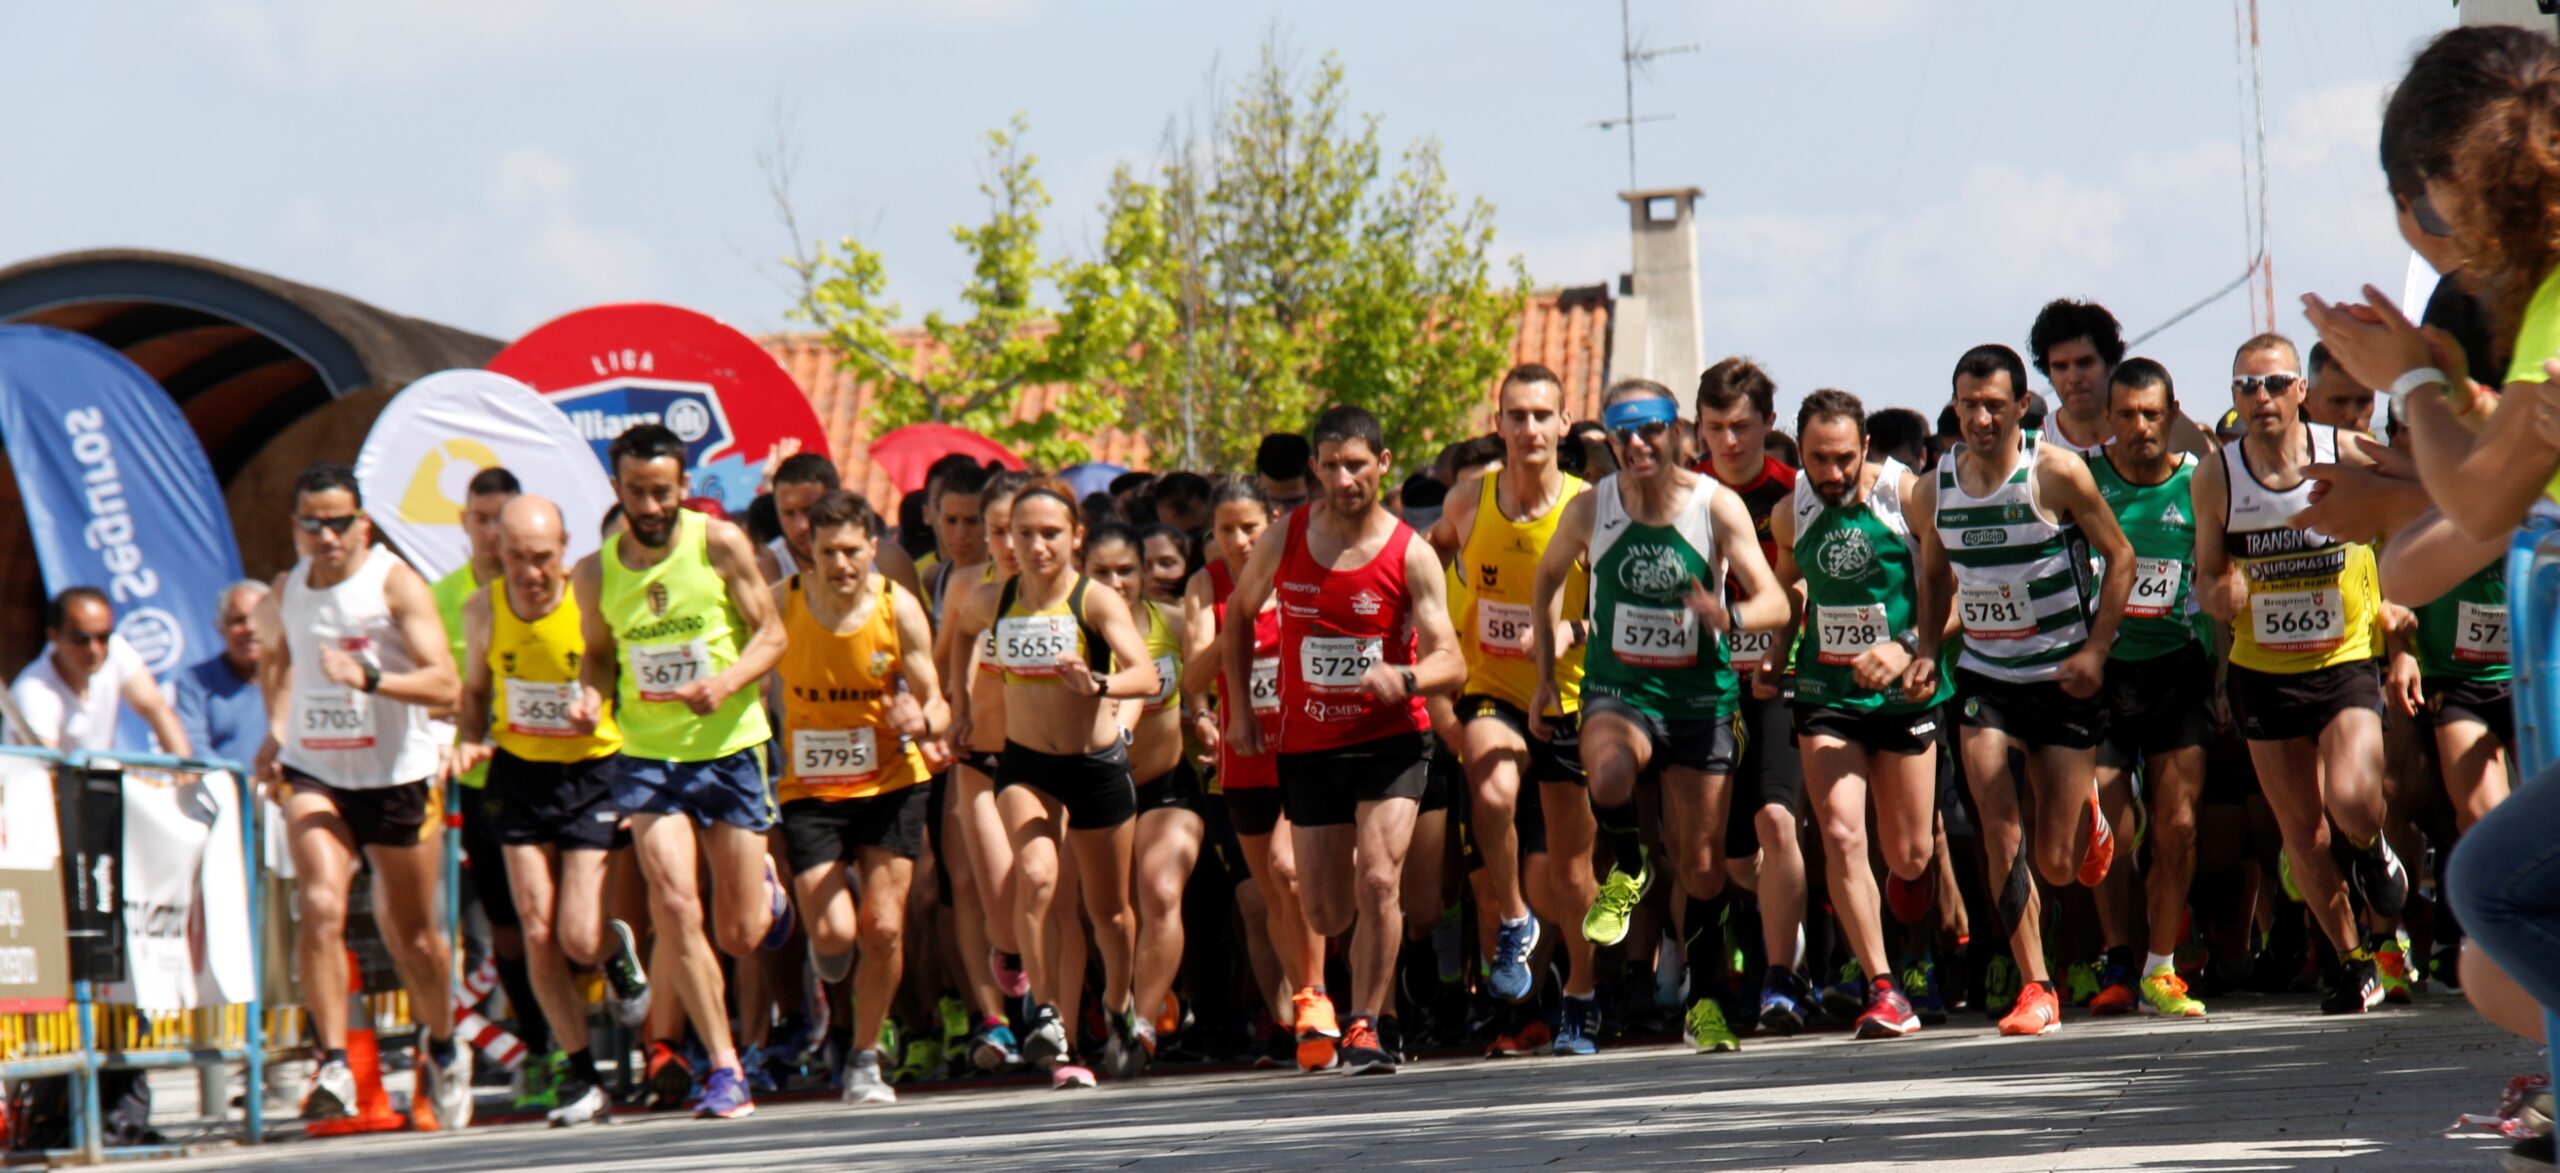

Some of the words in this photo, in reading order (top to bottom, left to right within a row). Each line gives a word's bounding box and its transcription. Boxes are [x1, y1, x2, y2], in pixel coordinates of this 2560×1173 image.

[591, 349, 654, 375] LIGA
[1965, 530, 2004, 545] Agriloja
[1965, 601, 2021, 622] 5781
[2266, 609, 2330, 634] 5663
[1624, 625, 1686, 649] 5734
[1824, 624, 1876, 645] 5738
[1008, 636, 1063, 658] 5655
[642, 661, 697, 684] 5677
[1312, 656, 1370, 677] 5729
[306, 709, 358, 729] 5703
[805, 748, 865, 768] 5795
